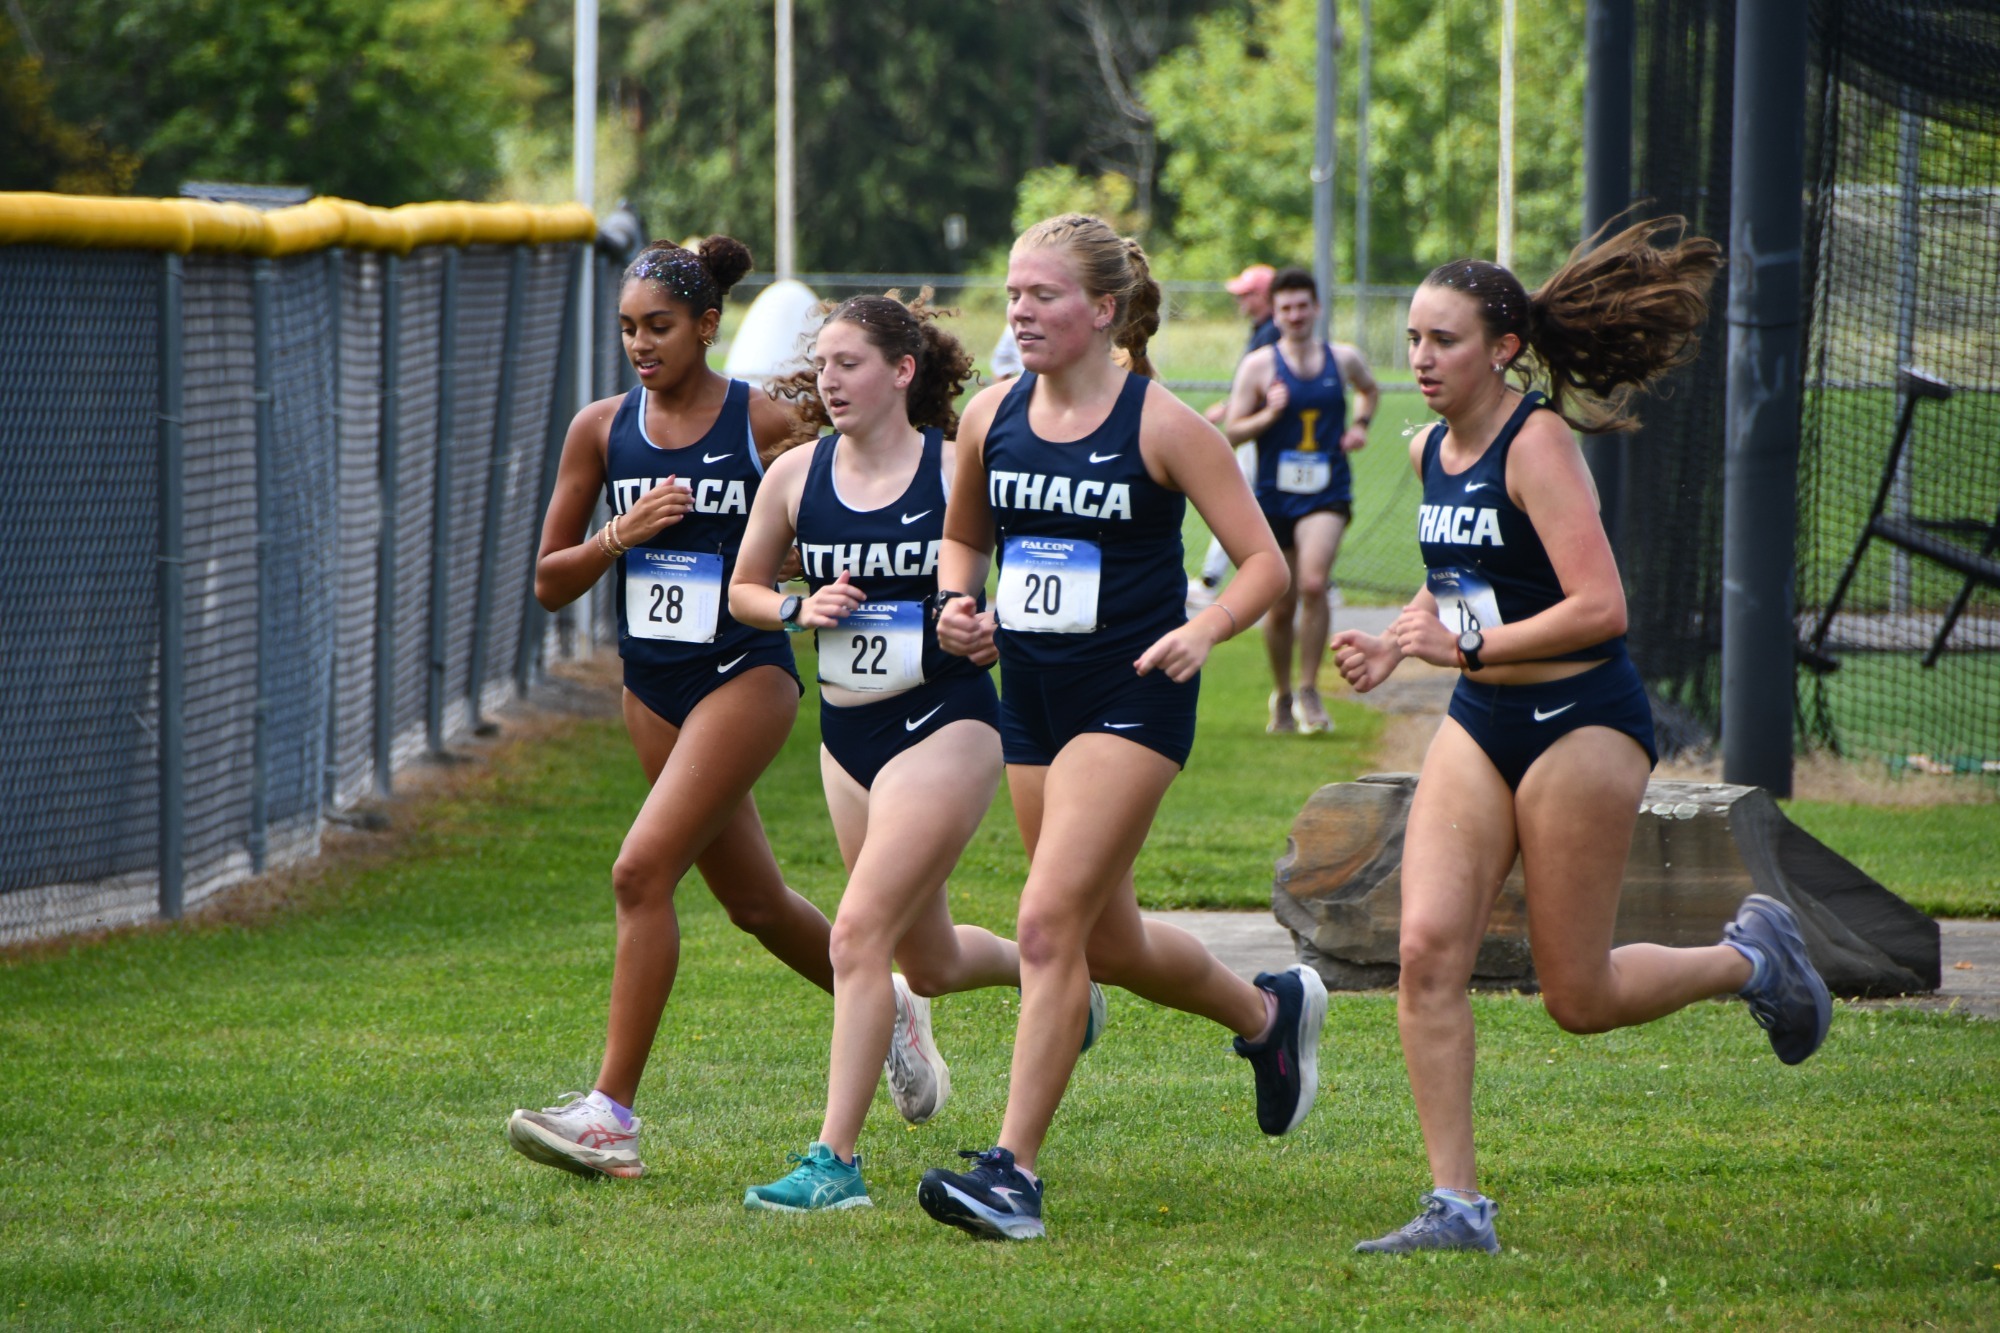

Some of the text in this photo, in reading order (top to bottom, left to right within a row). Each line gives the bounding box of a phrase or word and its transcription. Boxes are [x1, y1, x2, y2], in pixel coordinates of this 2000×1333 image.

[990, 470, 1132, 520] ITHACA
[645, 552, 698, 564] FALCON
[1021, 541, 1074, 551] FALCON
[648, 583, 684, 624] 28
[1024, 573, 1061, 616] 20
[851, 634, 888, 675] 22
